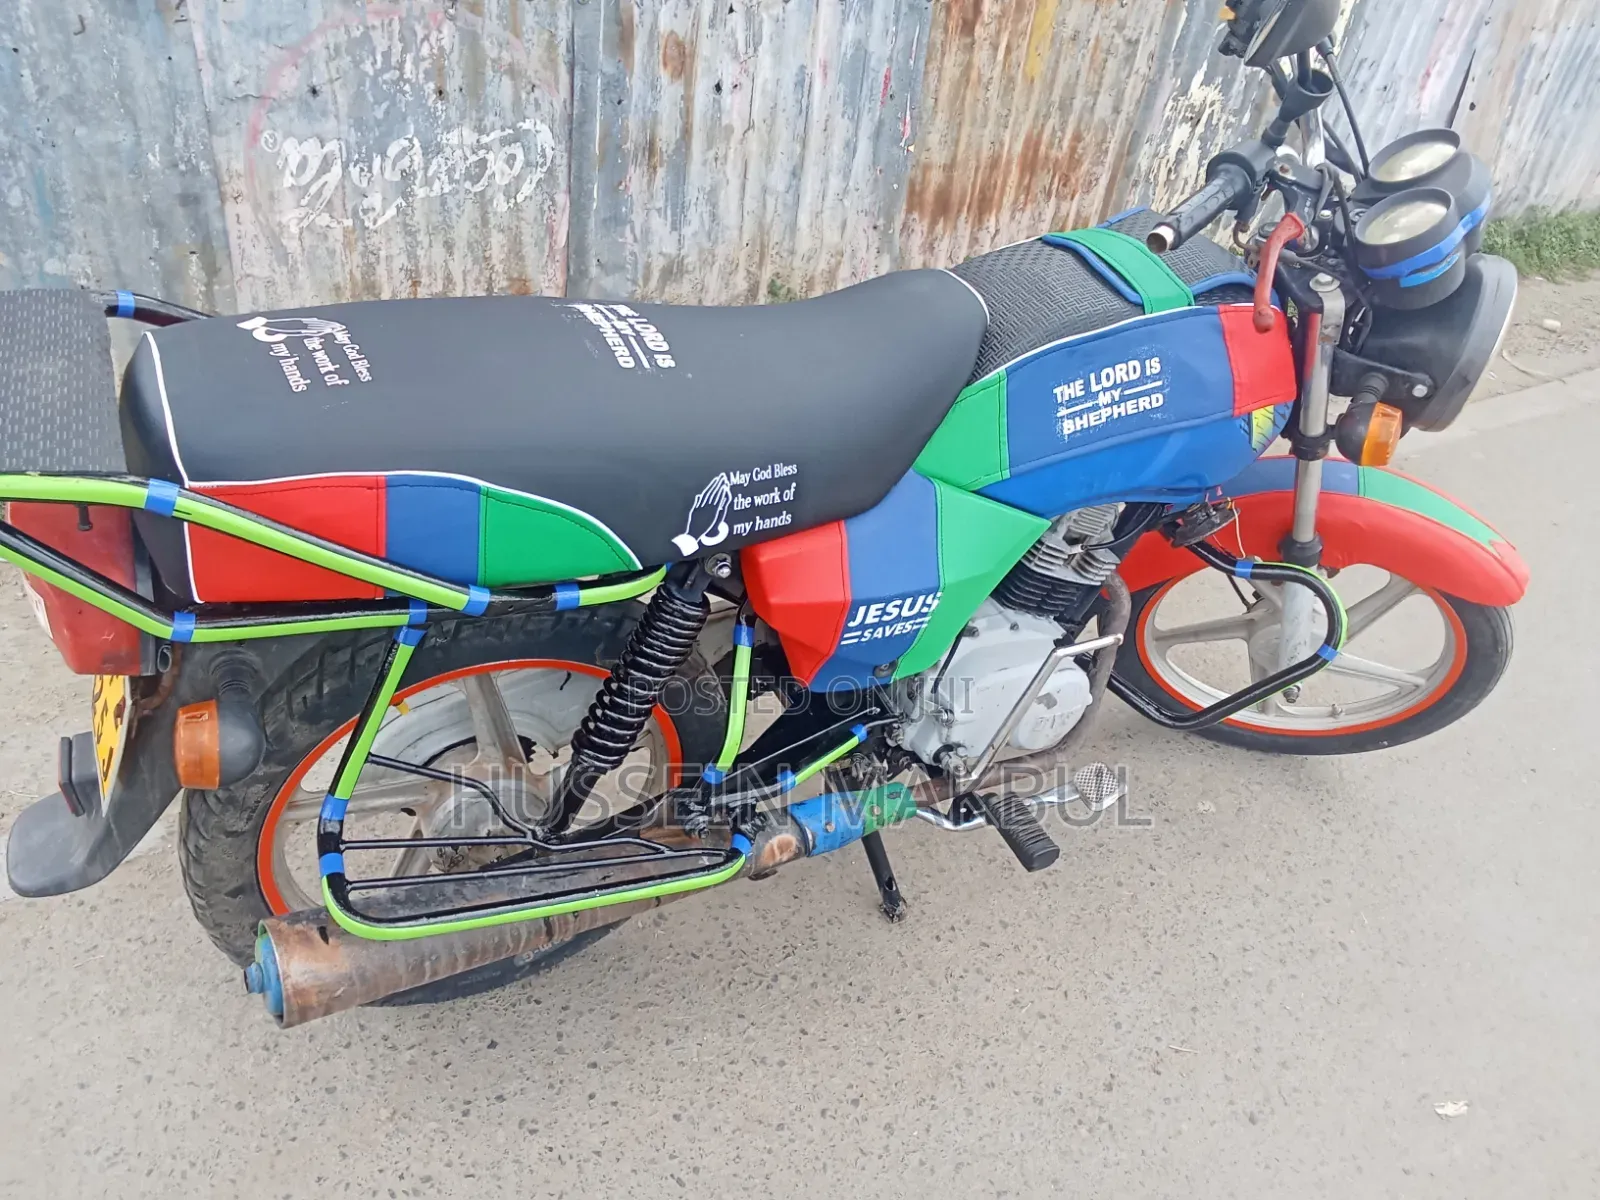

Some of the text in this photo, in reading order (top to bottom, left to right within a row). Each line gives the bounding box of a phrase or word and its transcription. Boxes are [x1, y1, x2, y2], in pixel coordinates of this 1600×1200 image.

[342, 344, 365, 360] God
[627, 318, 670, 352] LORD
[654, 353, 676, 368] IS
[269, 342, 311, 393] my hands
[303, 336, 350, 387] the work of
[350, 358, 372, 382] Bless
[1053, 357, 1162, 403] THE LORD IS
[1098, 387, 1122, 407] MY
[729, 462, 798, 487] May God Bless
[733, 481, 797, 511] the work of
[732, 510, 792, 537] my hands
[847, 592, 942, 627] JESUS
[860, 620, 914, 642] SAVES
